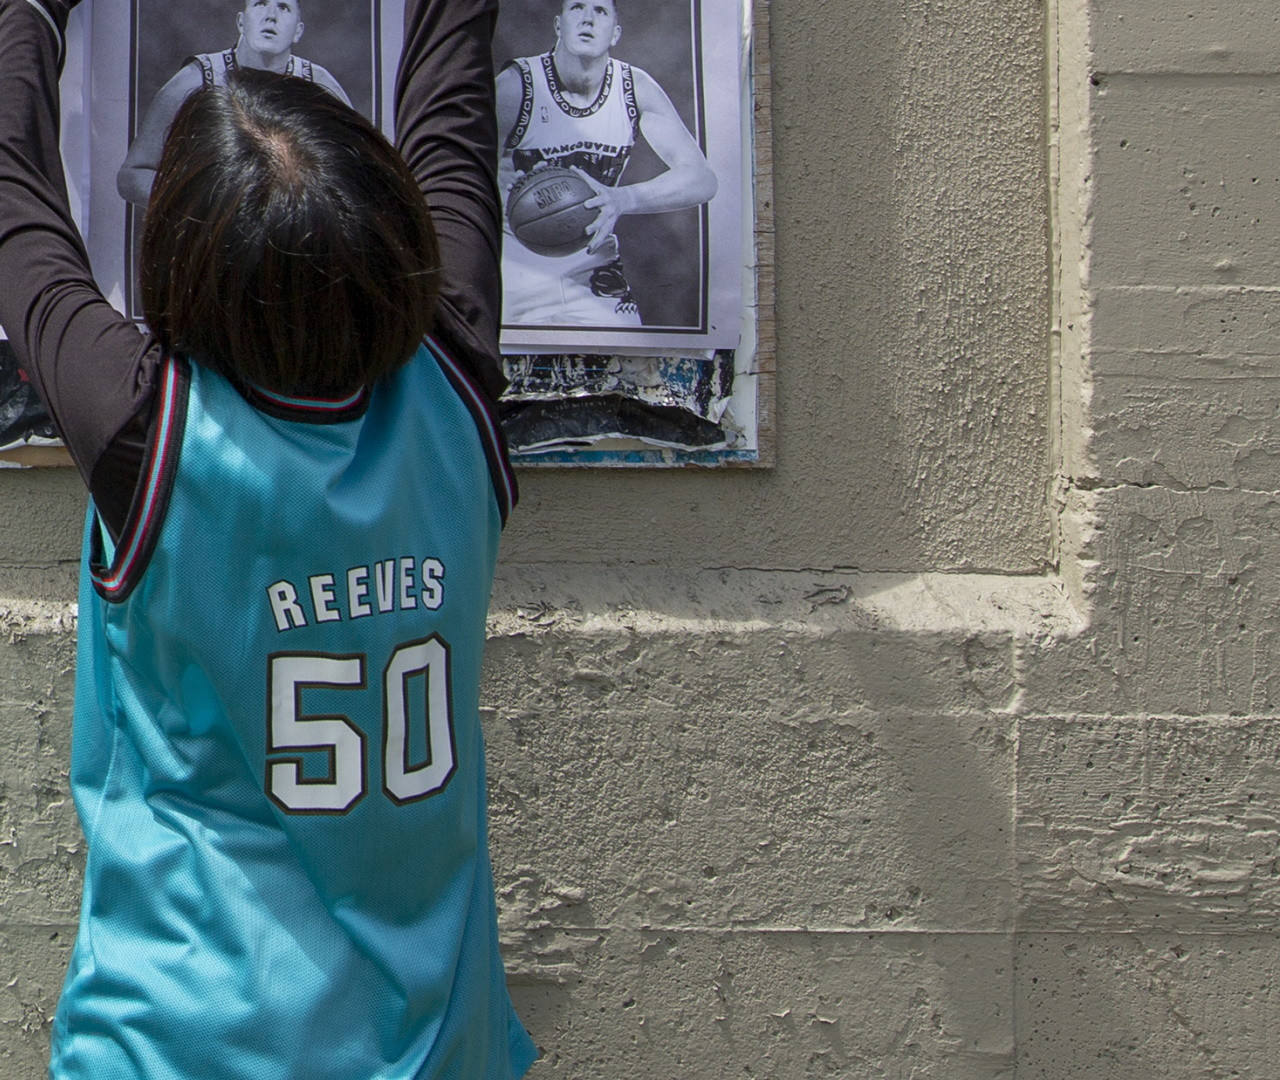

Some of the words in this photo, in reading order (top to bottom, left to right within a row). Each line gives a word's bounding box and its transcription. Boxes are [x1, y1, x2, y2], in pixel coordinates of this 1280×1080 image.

[542, 141, 618, 156] VANCOUVER
[266, 555, 446, 634] REEVES
[264, 631, 460, 817] 50
